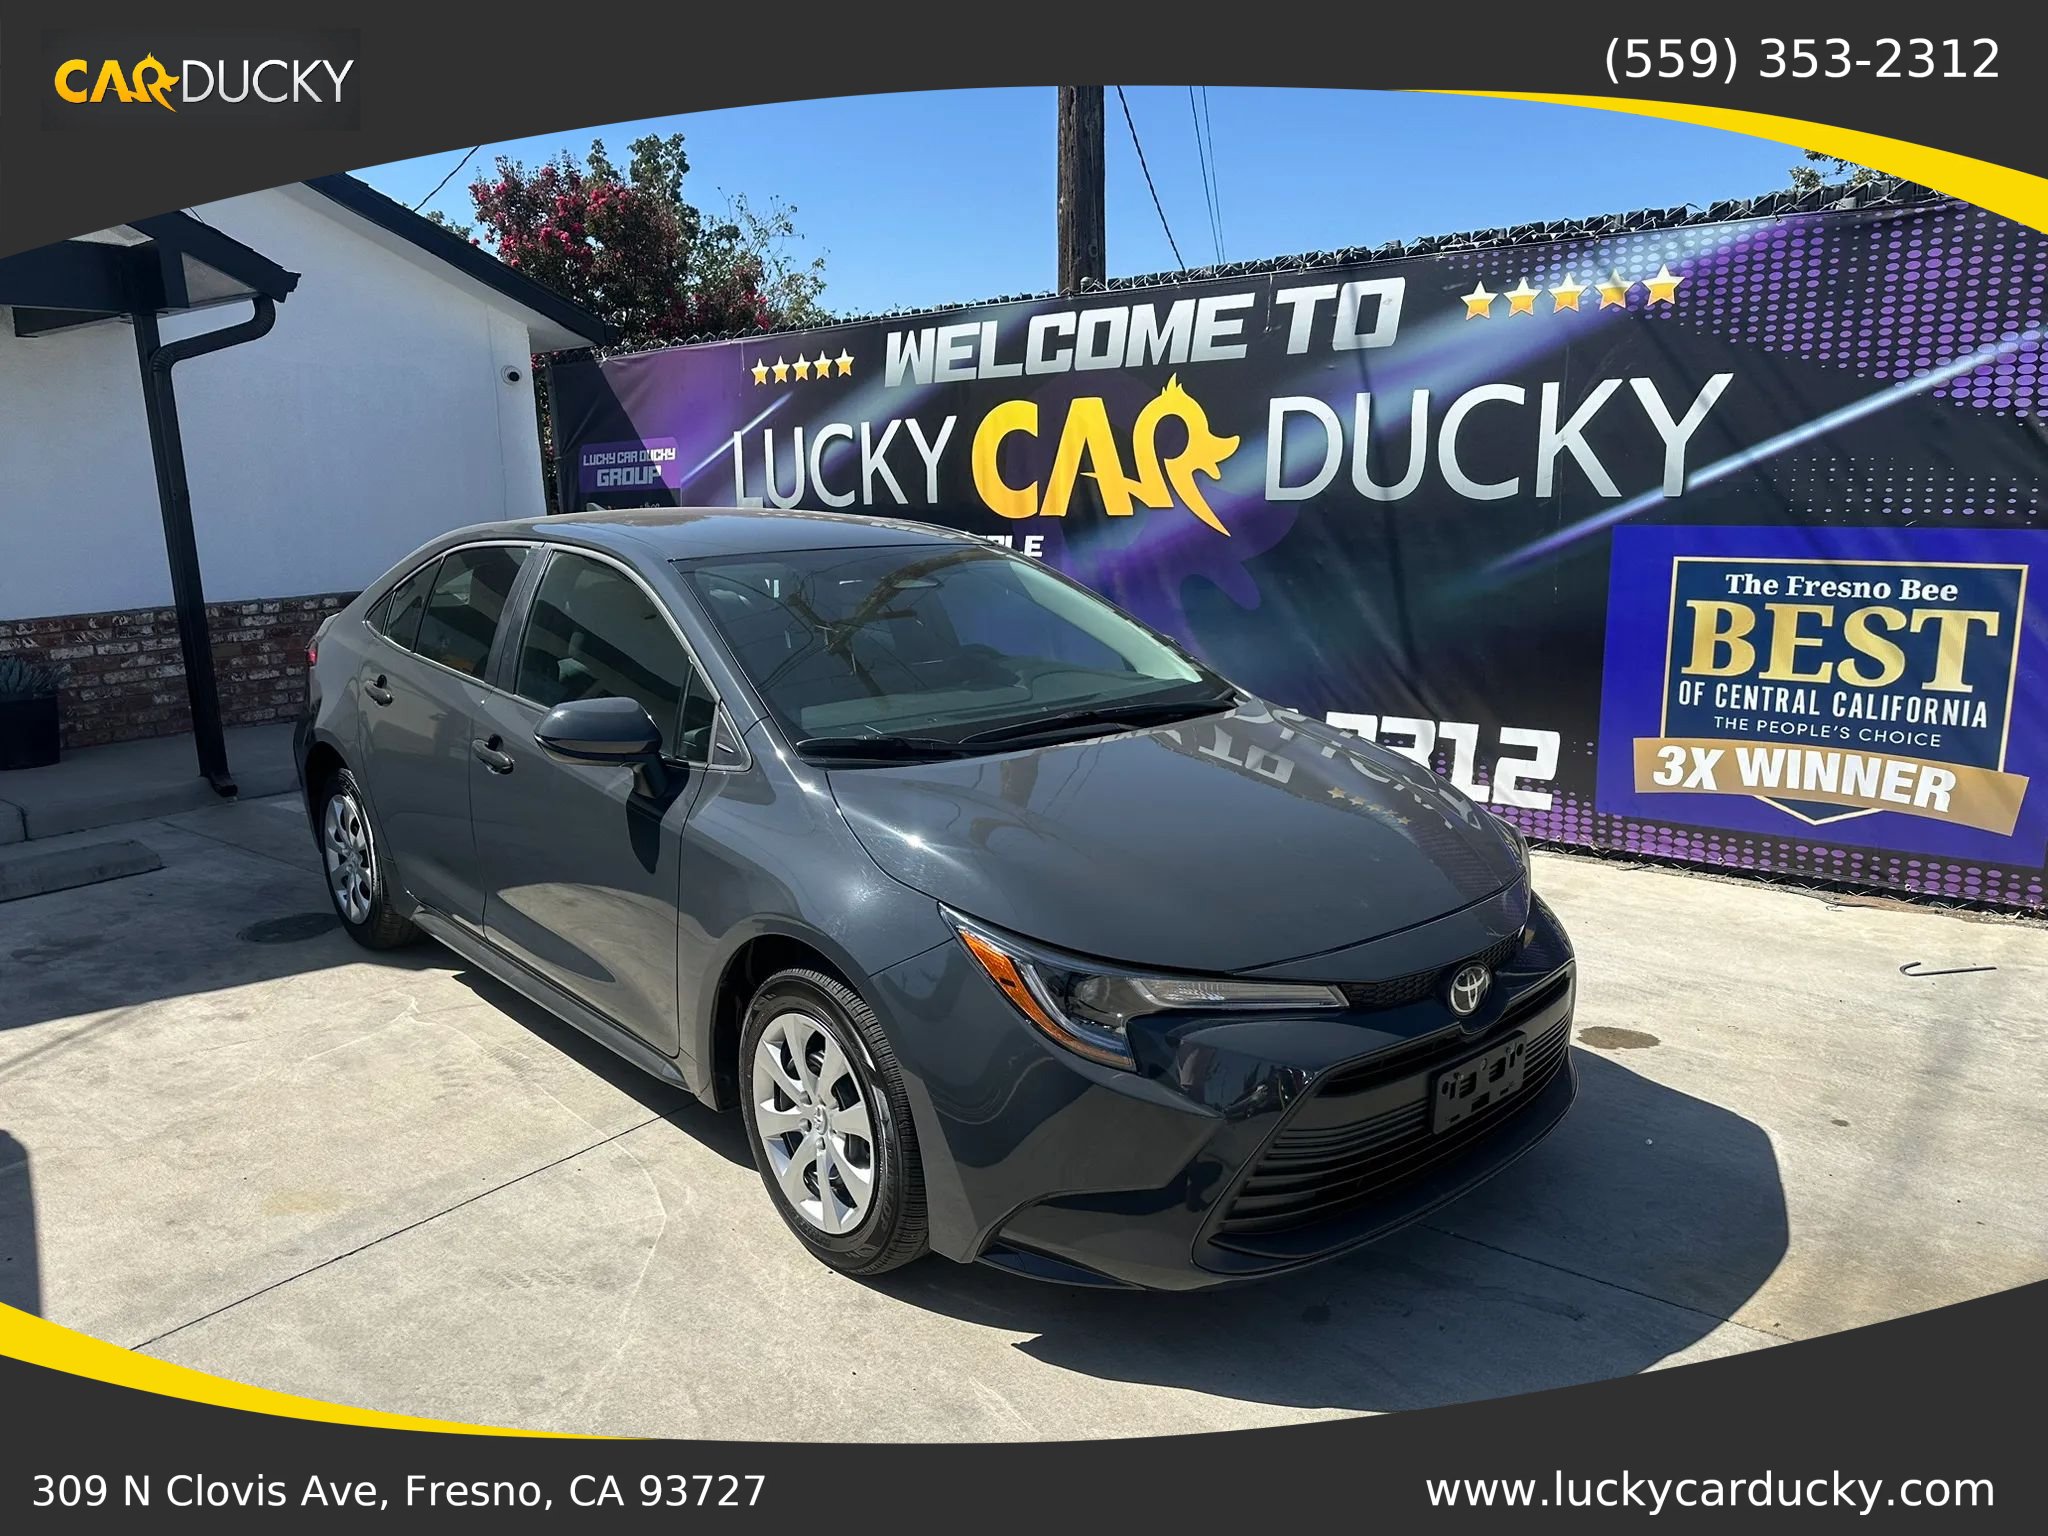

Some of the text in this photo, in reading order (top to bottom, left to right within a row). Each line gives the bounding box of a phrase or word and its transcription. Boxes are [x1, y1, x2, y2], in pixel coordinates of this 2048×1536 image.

[885, 277, 1406, 387] WELCOME TO
[583, 447, 676, 466] LUCKY CAR DUCKY
[597, 464, 662, 487] GROUP
[733, 372, 1735, 537] LUCKY CAR DUCKY
[1726, 573, 1959, 602] The Fresno Bee
[1680, 599, 2000, 694] BEST
[1678, 680, 1989, 729] OF CENTRAL CALIFORNIA
[1714, 716, 1942, 748] THE PEOPLE'S CHOICE
[1652, 745, 1957, 813] 3X WINNER
